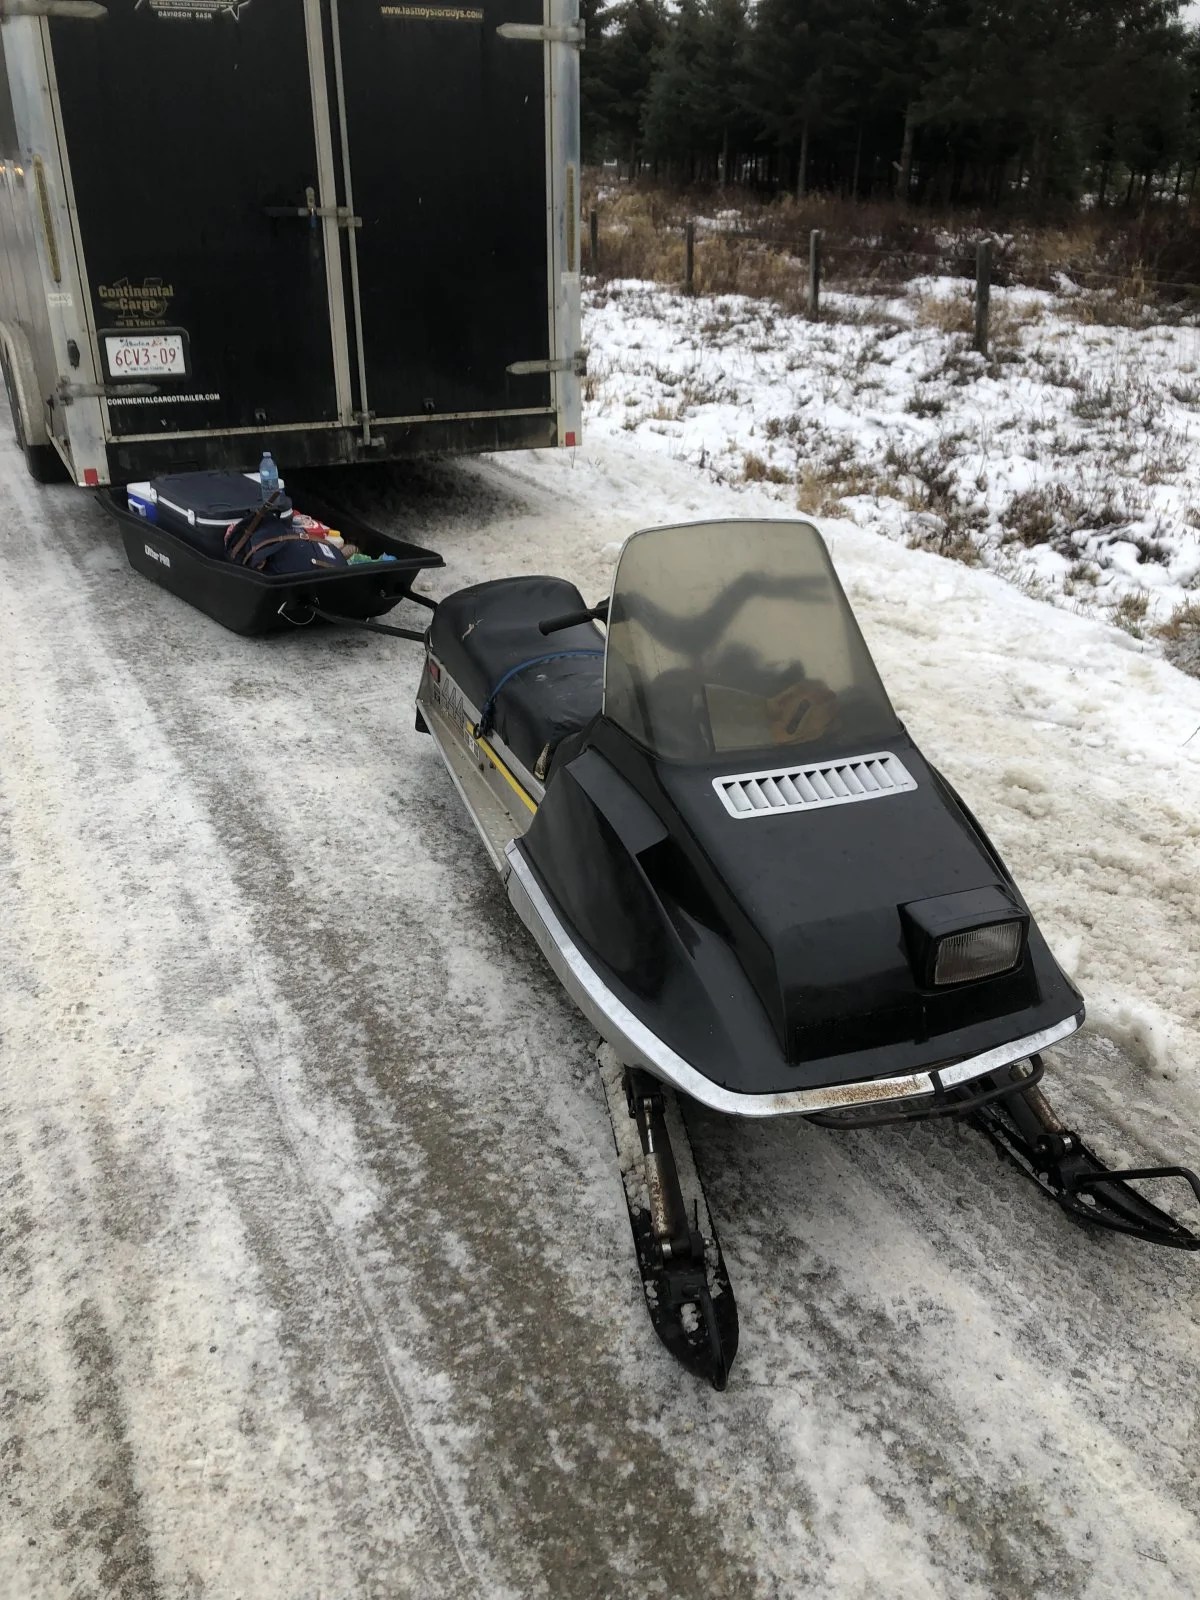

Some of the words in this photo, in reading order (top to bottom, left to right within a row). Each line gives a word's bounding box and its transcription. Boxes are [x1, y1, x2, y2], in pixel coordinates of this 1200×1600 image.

[157, 10, 192, 18] DAVIDSON
[195, 11, 212, 19] SASK
[98, 284, 174, 297] Continental
[120, 297, 157, 311] Cargo
[115, 347, 176, 367] 6CV3-09
[107, 393, 220, 406] CONTINENTALCARGOTRAILER.COM
